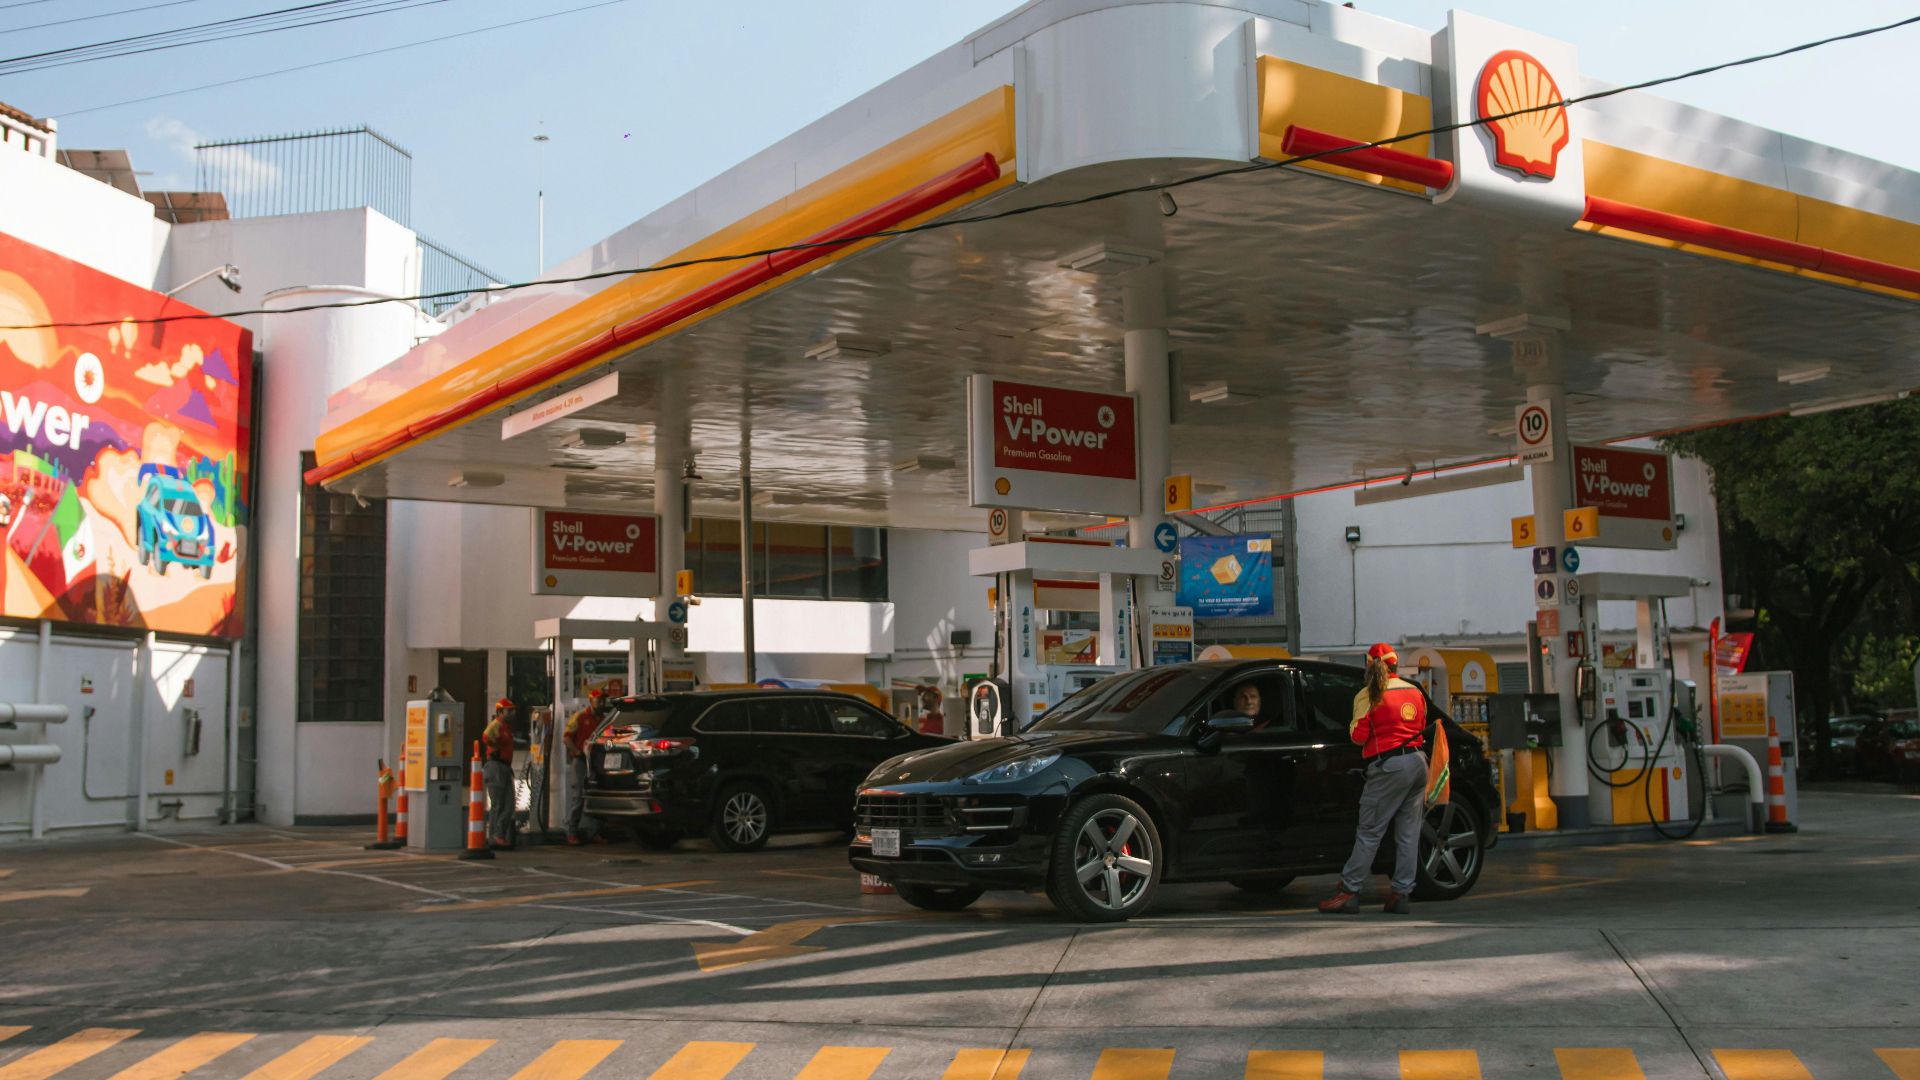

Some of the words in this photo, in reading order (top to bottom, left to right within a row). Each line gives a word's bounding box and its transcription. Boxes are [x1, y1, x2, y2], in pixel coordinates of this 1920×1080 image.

[1003, 396, 1042, 416] Shell
[0, 390, 90, 450] wer
[1525, 413, 1542, 432] 10
[1004, 415, 1107, 449] V-Power
[1003, 446, 1037, 459] Premium
[1038, 449, 1072, 462] Gasoline
[1581, 458, 1607, 473] Shell
[1168, 485, 1177, 504] 8
[1582, 474, 1651, 497] V-Power
[552, 521, 583, 533] Shell
[993, 514, 1002, 527] 10
[1572, 516, 1583, 533] 6
[1520, 523, 1529, 540] 5
[553, 534, 634, 554] V-Power
[552, 554, 578, 563] Premium
[579, 555, 605, 564] Gasoline
